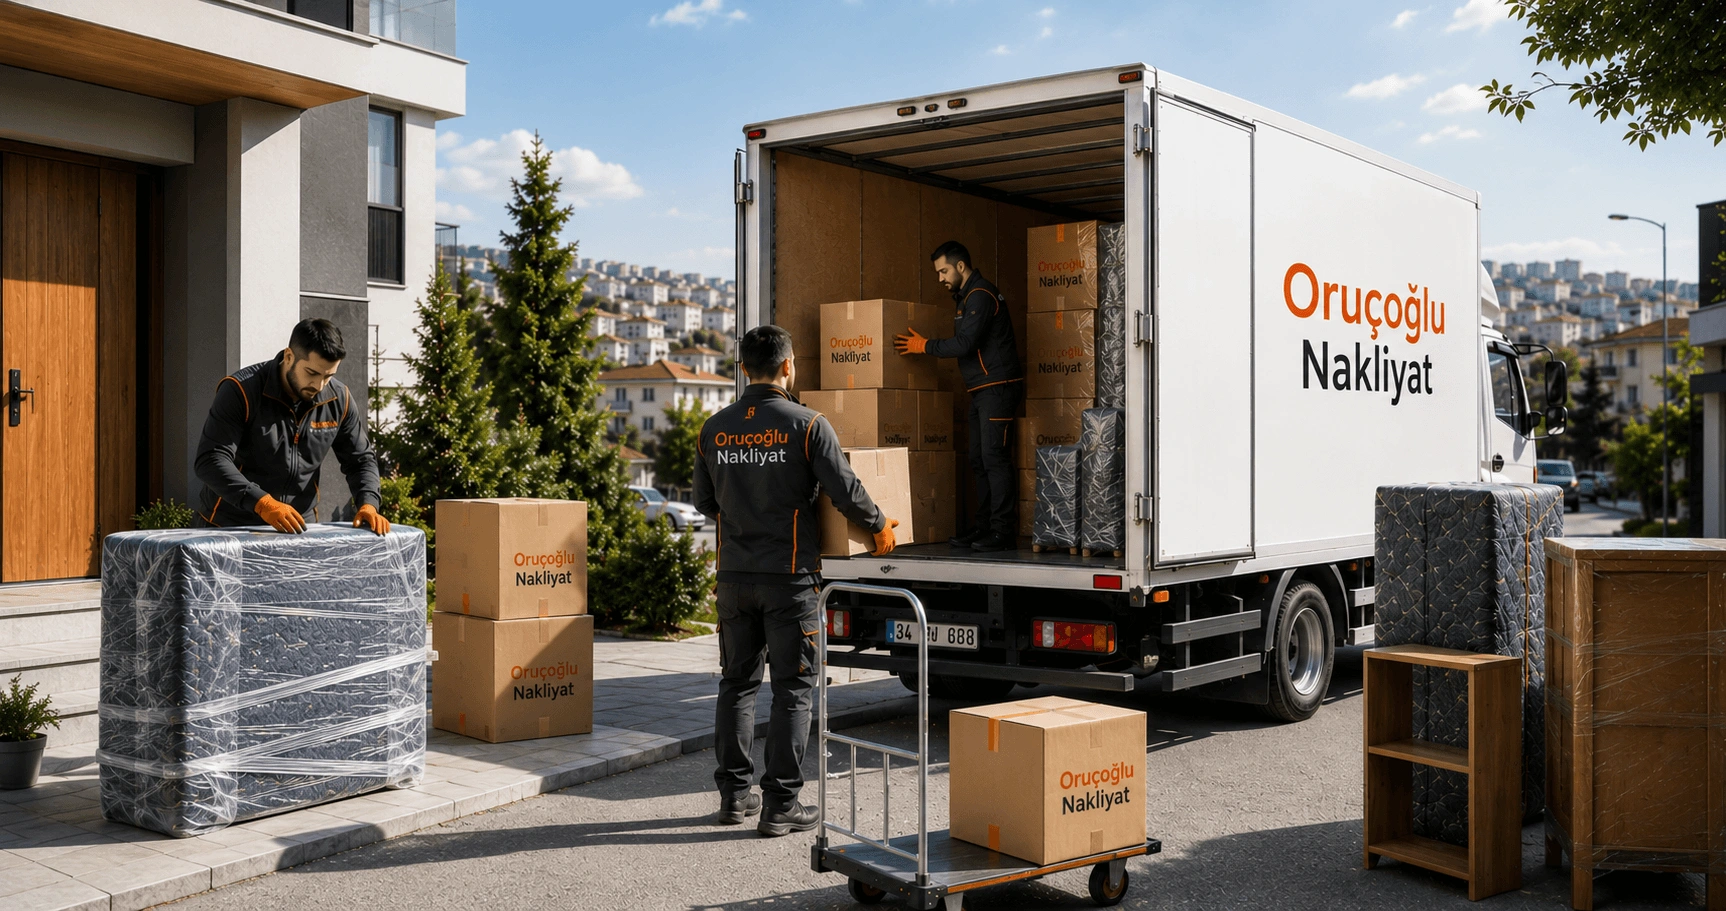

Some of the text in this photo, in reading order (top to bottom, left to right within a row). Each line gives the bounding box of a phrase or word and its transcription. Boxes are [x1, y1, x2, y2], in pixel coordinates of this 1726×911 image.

[1039, 274, 1083, 288] Nakliyat
[1283, 262, 1445, 344] Oruçoğlu
[830, 335, 873, 350] Oruçoğlu
[831, 350, 871, 365] Nakliyat
[1038, 362, 1082, 376] Nakliyat
[1302, 338, 1433, 406] Nakliyat
[714, 429, 789, 448] Oruçoğlu
[717, 448, 786, 467] Nakliyat
[514, 550, 575, 569] Oruçoğlu
[516, 570, 572, 588] Nakliyat
[896, 623, 912, 640] 34
[510, 661, 578, 681] Oruçoğlu
[513, 682, 575, 701] Nakliyat
[1060, 761, 1134, 790] Oruçoğlu
[1062, 787, 1130, 815] Nakliyat
